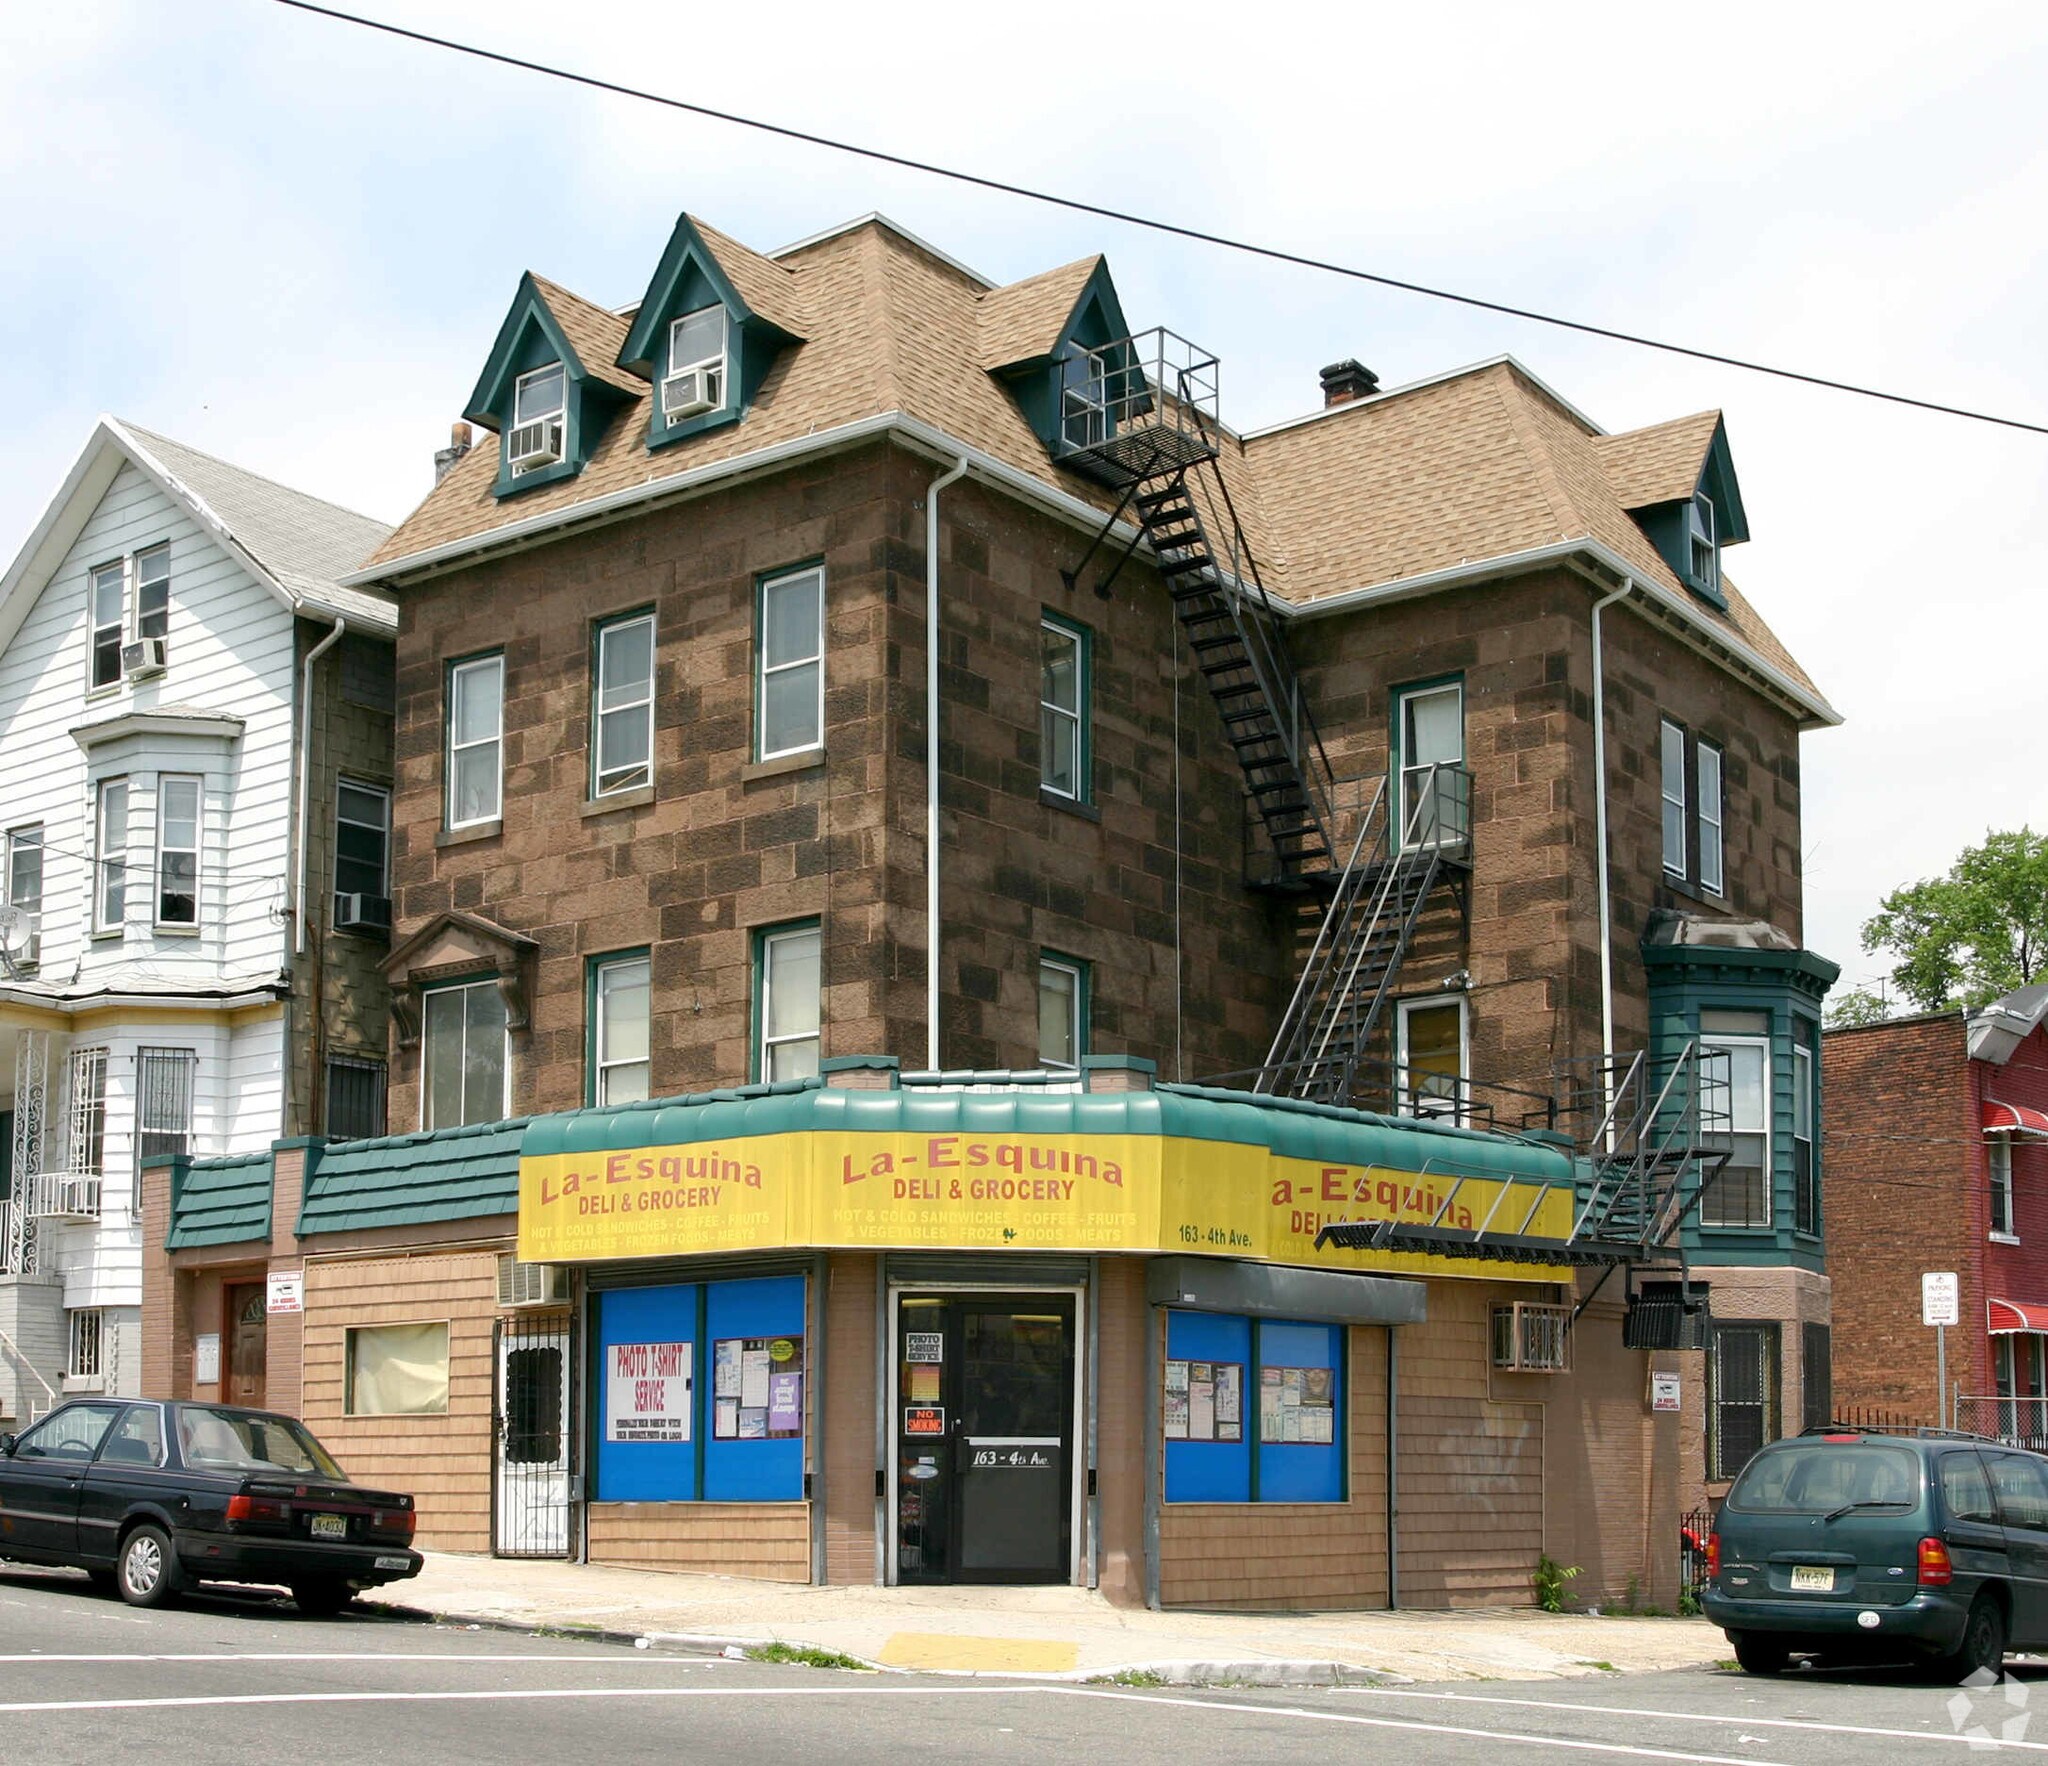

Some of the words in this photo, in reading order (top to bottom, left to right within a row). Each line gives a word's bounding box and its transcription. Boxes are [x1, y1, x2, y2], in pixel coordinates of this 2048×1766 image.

[843, 1137, 1124, 1188] La-Esquina
[541, 1151, 762, 1206] La-Esquina
[894, 1179, 940, 1200] DELI
[950, 1179, 962, 1200] &
[970, 1179, 1075, 1200] GROCERY
[1271, 1168, 1474, 1231] a-Esquina
[579, 1193, 615, 1216] DELI
[621, 1193, 632, 1212] &
[637, 1186, 722, 1212] GROCERY
[566, 1224, 594, 1237] COLD
[676, 1216, 720, 1230] COFFEE
[728, 1212, 770, 1227] FRUITS
[833, 1208, 860, 1222] HOT
[866, 1208, 876, 1222] &
[880, 1210, 916, 1223] COLD
[920, 1210, 1010, 1225] SANDWICHES
[1023, 1212, 1078, 1226] COFFEE
[1087, 1212, 1137, 1226] FRUITS
[626, 1233, 669, 1248] FROZEN
[671, 1231, 709, 1245] FOODS
[859, 1226, 948, 1239] VEGETABLES
[959, 1228, 1014, 1241] FROZE
[1078, 1228, 1122, 1242] MEATS
[1178, 1224, 1198, 1243] 163
[1208, 1227, 1226, 1245] 4th
[1229, 1229, 1252, 1248] Ave.
[908, 1334, 940, 1344] PHOTO
[909, 1344, 940, 1353] T-SHIRT
[617, 1346, 647, 1378] PHOTO
[651, 1344, 683, 1377] T-SHIRT
[634, 1380, 664, 1412] SERVICE
[916, 1410, 934, 1419] NO
[908, 1419, 942, 1432] SMOKING
[973, 1450, 997, 1465] 163
